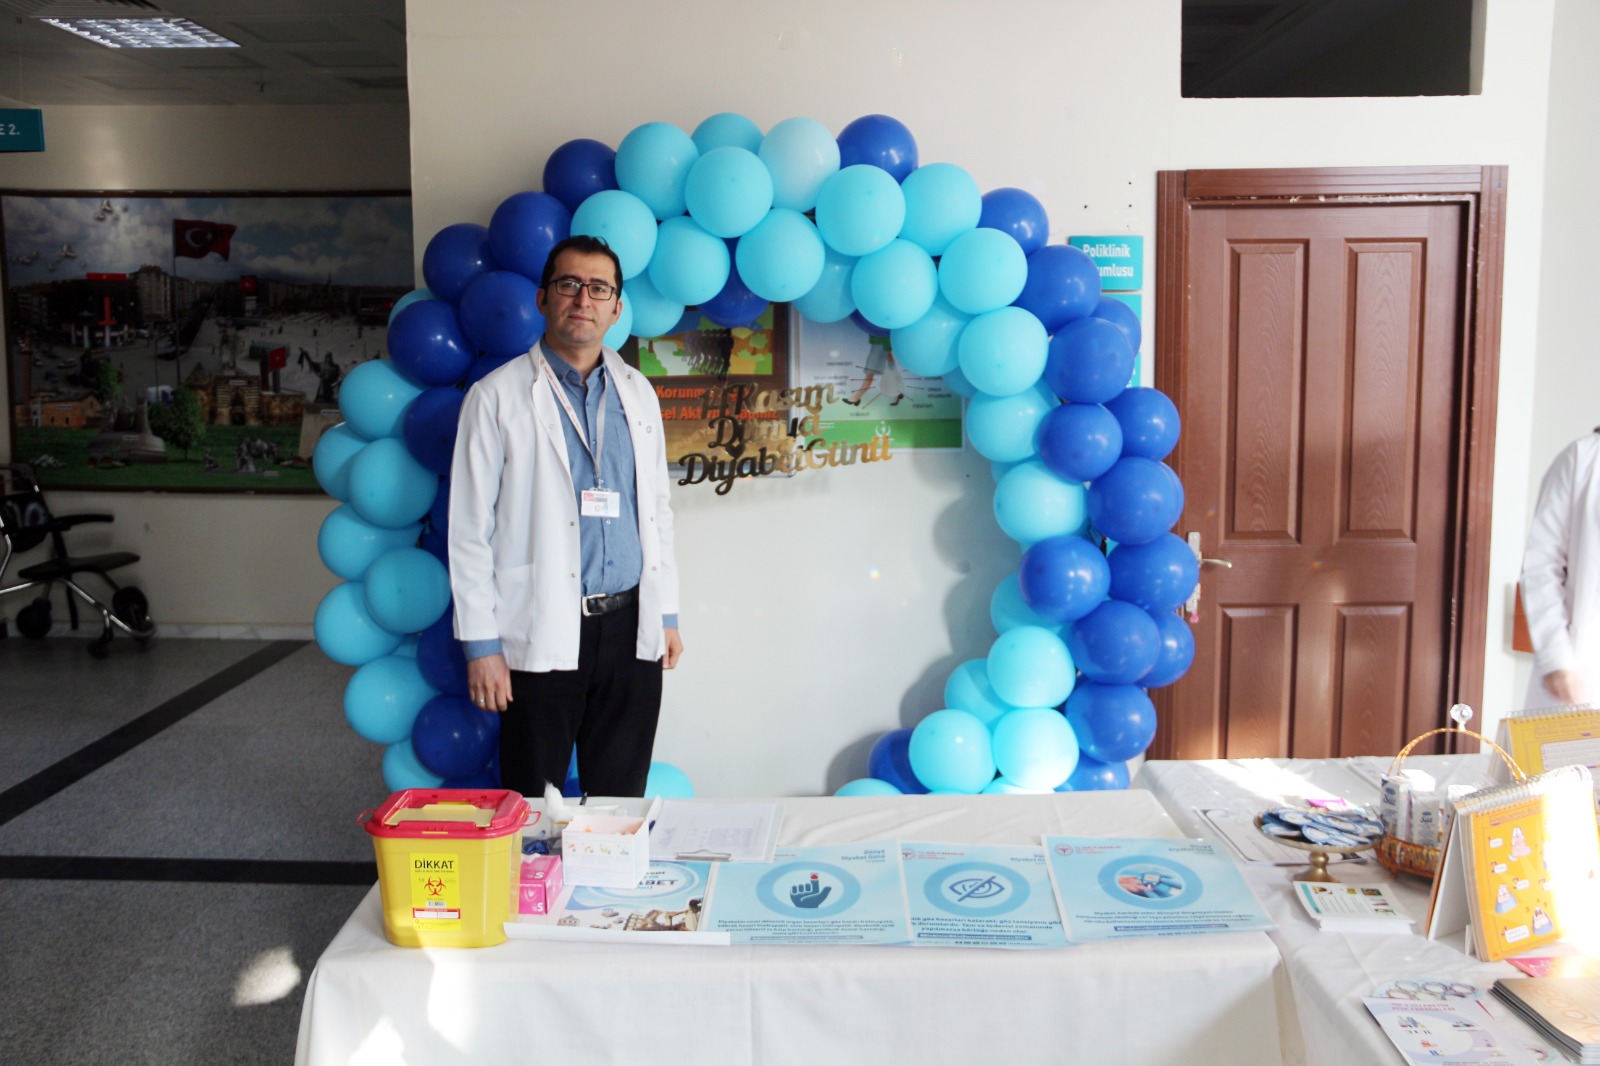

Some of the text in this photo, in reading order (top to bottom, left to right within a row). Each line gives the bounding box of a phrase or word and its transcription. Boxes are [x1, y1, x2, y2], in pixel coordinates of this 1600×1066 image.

[8, 124, 20, 135] 2.
[1083, 243, 1131, 257] Poliklinik
[1097, 263, 1134, 277] umlusu
[803, 434, 894, 470] Günü
[414, 858, 454, 870] DİKKAT
[537, 902, 544, 912] S
